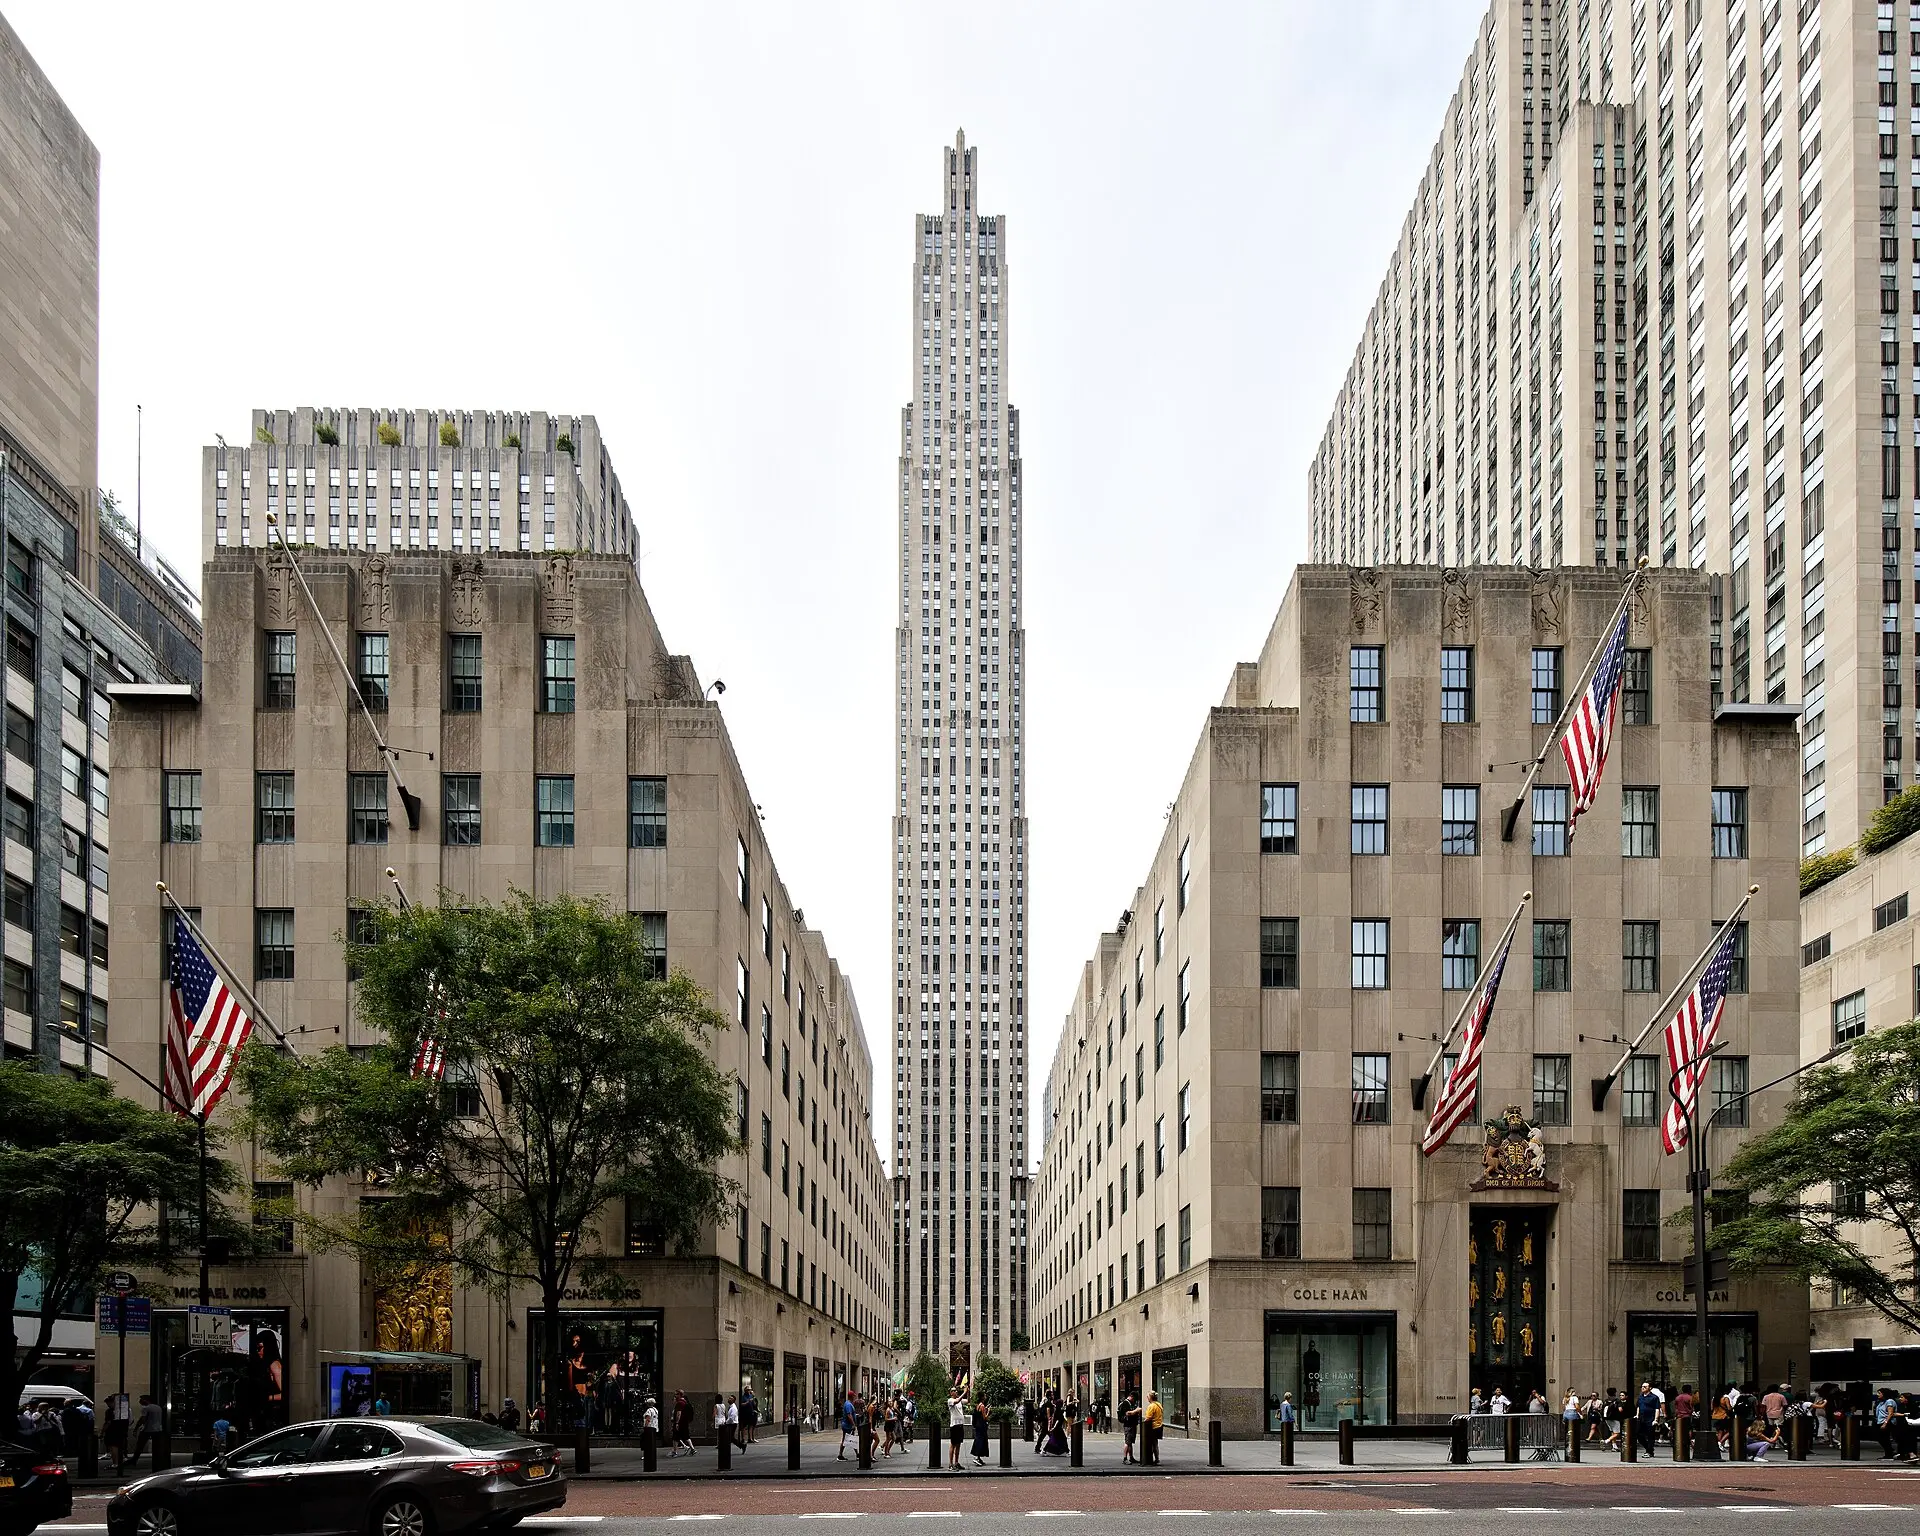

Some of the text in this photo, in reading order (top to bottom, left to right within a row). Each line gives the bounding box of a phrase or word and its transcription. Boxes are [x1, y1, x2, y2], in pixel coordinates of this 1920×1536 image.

[174, 1288, 266, 1298] MICAEL KORS
[1294, 1290, 1368, 1300] COLE HAAN
[1656, 1291, 1728, 1302] COLE AAN
